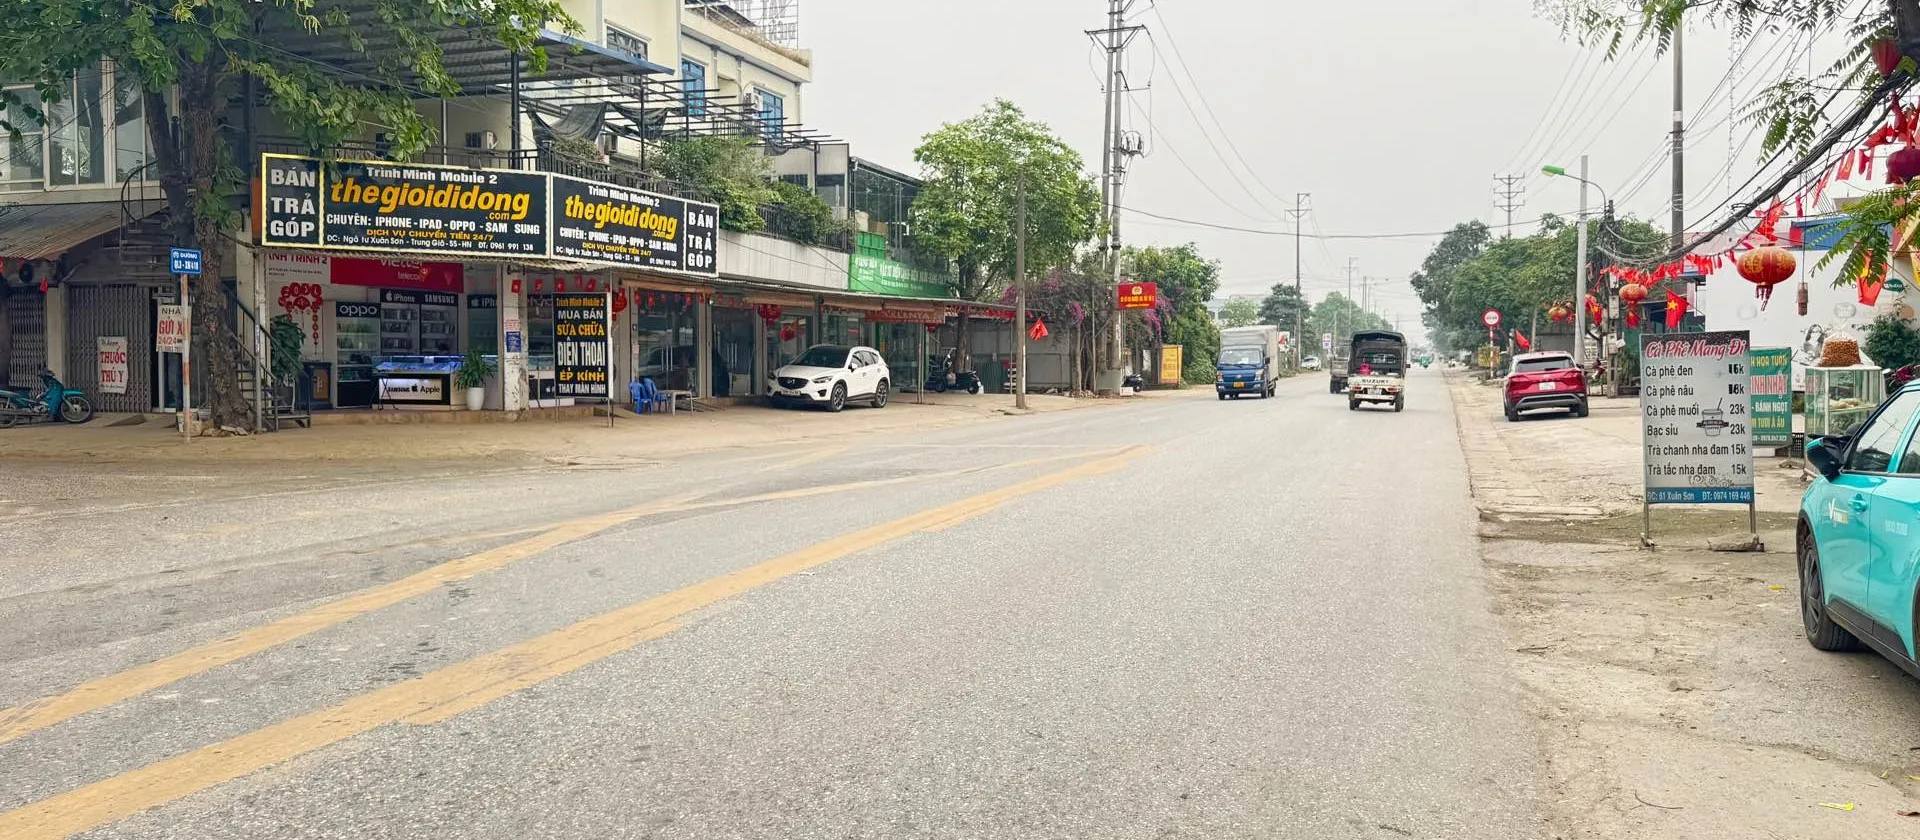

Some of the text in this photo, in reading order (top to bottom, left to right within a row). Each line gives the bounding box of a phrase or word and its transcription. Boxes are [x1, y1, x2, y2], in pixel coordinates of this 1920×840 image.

[271, 166, 316, 188] BÁN
[402, 168, 436, 181] Minh
[440, 171, 485, 184] Mobile
[489, 174, 498, 185] 2
[271, 192, 316, 215] TRẢ
[330, 177, 530, 220] thegioididong
[610, 189, 629, 202] Minh
[630, 193, 654, 206] Mobile
[654, 198, 660, 208] 2
[326, 212, 372, 226] CHUYÊN:
[375, 216, 412, 228] IPHONE
[420, 218, 442, 230] IPAD
[450, 220, 476, 232] OPPO
[486, 222, 508, 234] SAM
[514, 224, 540, 234] SUNG
[565, 194, 678, 240] thegioididong
[688, 210, 714, 228] BÁN
[270, 216, 315, 238] GÓP
[366, 229, 390, 238] DỊCH
[392, 230, 406, 238] VỤ
[370, 236, 390, 245] Xuân
[411, 238, 430, 248] Trung
[688, 232, 712, 250] TRẢ
[688, 250, 712, 268] GÓP
[393, 294, 455, 304] iPhone SAMSUNG
[558, 308, 603, 320] MUA BÁN
[557, 321, 605, 336] SỬA CHỮA
[100, 346, 126, 364] THUỐC
[557, 336, 578, 371] ĐIỆN
[580, 341, 606, 371] THOẠI
[1645, 338, 1747, 361] Cà Phê Mang Đi
[1756, 355, 1770, 367] HOA
[101, 366, 124, 382] THÚ Y
[560, 369, 605, 382] ÉP KÍNH
[1645, 365, 1657, 377] Cà
[1659, 365, 1675, 379] phê
[1677, 365, 1693, 376] đen
[421, 386, 440, 394] Apple
[558, 384, 574, 394] THAY
[591, 382, 606, 394] HÌNH
[1646, 385, 1657, 396] Cà
[1660, 385, 1676, 398] phê
[1678, 384, 1694, 396] nâu
[1767, 370, 1788, 399] NHẬT
[1646, 402, 1745, 419] Cà phê muối 23k
[1755, 399, 1772, 412] BÁNH
[1772, 402, 1788, 414] NGỌT
[1647, 425, 1663, 438] Bạc
[1730, 424, 1746, 435] 23k
[1648, 444, 1746, 455] Trà chanh nha đam 15k
[1648, 462, 1746, 475] Trà tắc nha đam 15k
[1667, 491, 1682, 500] Xuân
[1729, 491, 1739, 500] 169
